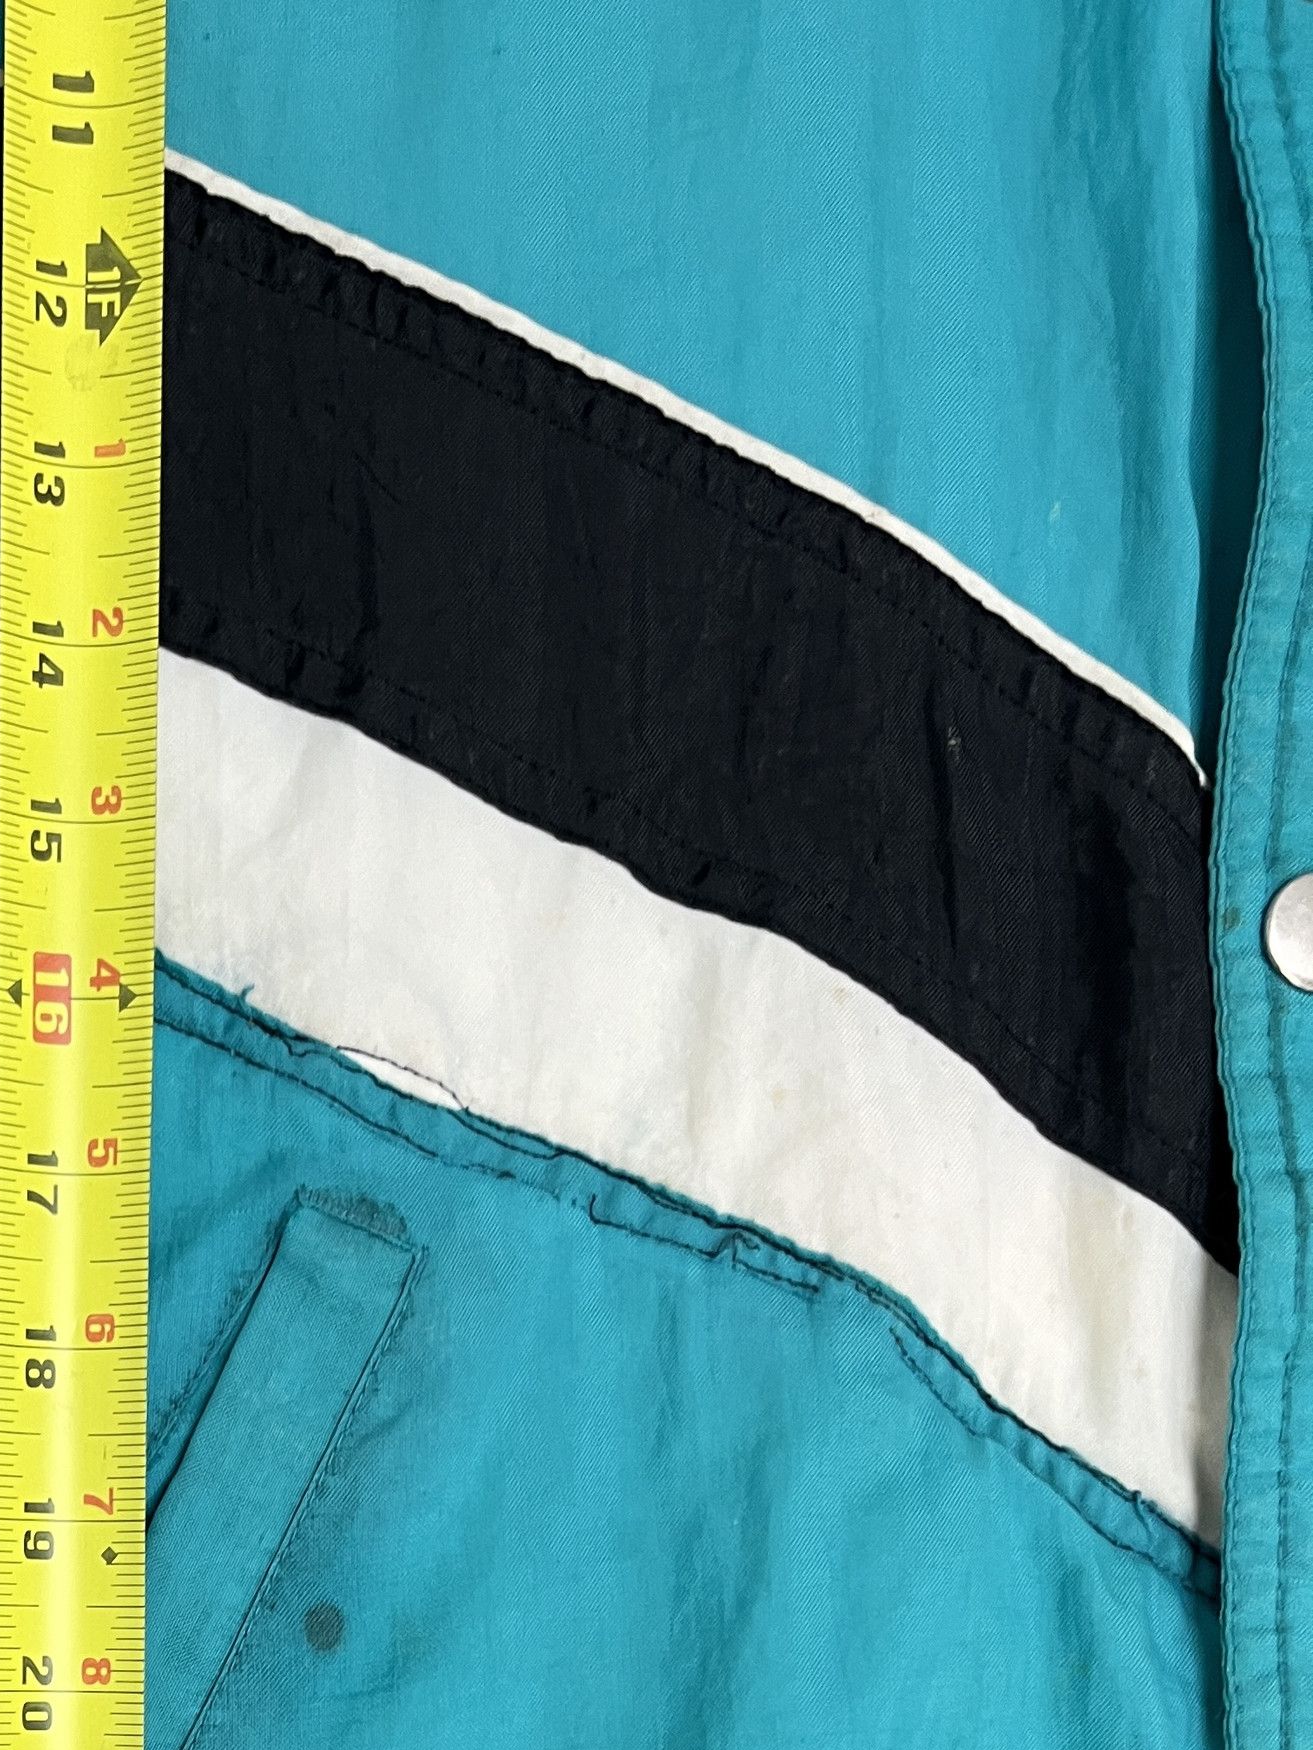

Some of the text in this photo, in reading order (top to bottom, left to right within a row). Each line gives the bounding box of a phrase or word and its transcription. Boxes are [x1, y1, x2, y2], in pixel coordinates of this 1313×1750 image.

[51, 69, 96, 146] 11
[34, 257, 69, 327] 12
[33, 439, 67, 509] 13
[93, 439, 127, 461] 1
[31, 619, 65, 689] 14
[91, 604, 124, 640] 2
[30, 795, 63, 864] 15
[90, 785, 123, 818] 3
[35, 962, 70, 1037] 16
[88, 957, 121, 993] 4
[26, 1148, 59, 1216] 17
[87, 1137, 119, 1169] 5
[24, 1323, 58, 1390] 18
[83, 1313, 116, 1345] 6
[23, 1496, 56, 1562] 19
[82, 1486, 114, 1517] 7
[21, 1655, 54, 1733] 20
[80, 1656, 113, 1687] 8
